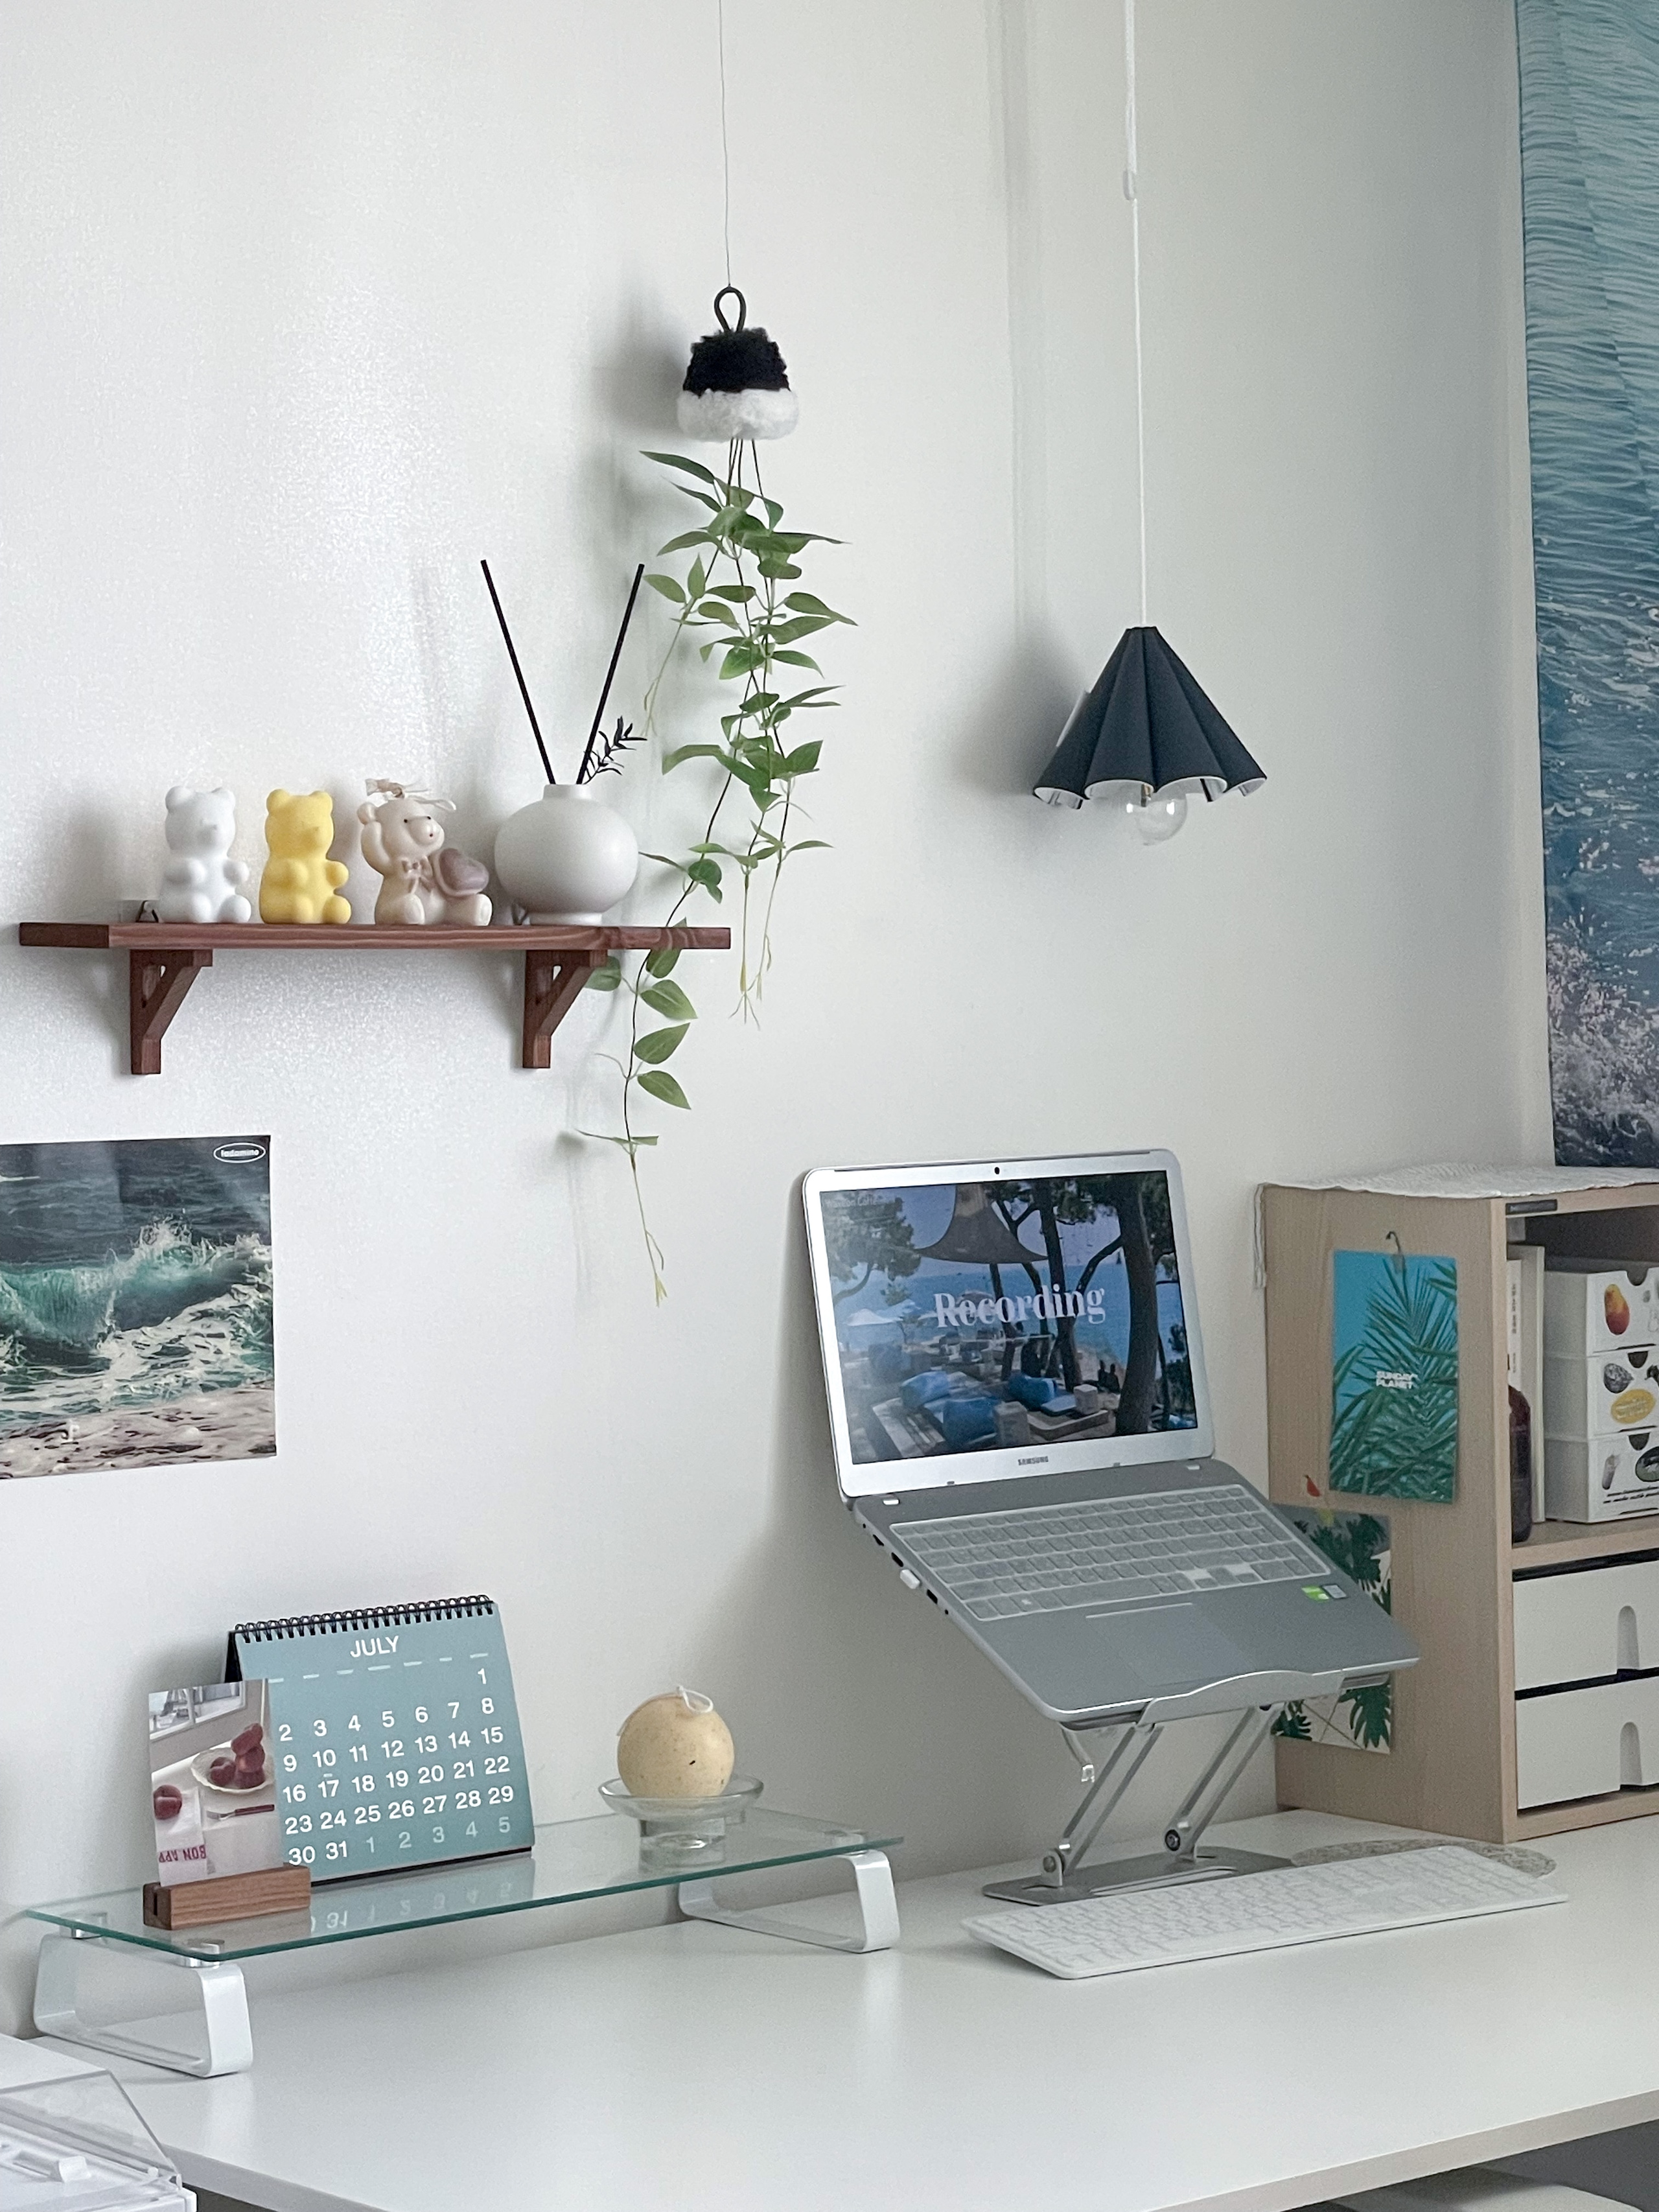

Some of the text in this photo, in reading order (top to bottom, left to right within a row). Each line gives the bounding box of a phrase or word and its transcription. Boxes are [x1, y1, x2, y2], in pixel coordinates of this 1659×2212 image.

[934, 1284, 1106, 1328] Recording
[1018, 1456, 1049, 1465] SAMSUNG
[351, 1636, 399, 1657] JULY
[478, 1668, 486, 1684] 1
[279, 1698, 494, 1741] 2 3 4 5 6 7 8
[283, 1727, 504, 1772] 9 10 11 12 13 14 15
[282, 1756, 510, 1803] 16 17 18 19 20 21 22
[285, 1786, 514, 1835] 23 24 25 26 27 28 29
[159, 1845, 207, 1863] BON APP
[288, 1817, 511, 1865] 30 31 1 2 3 4 5
